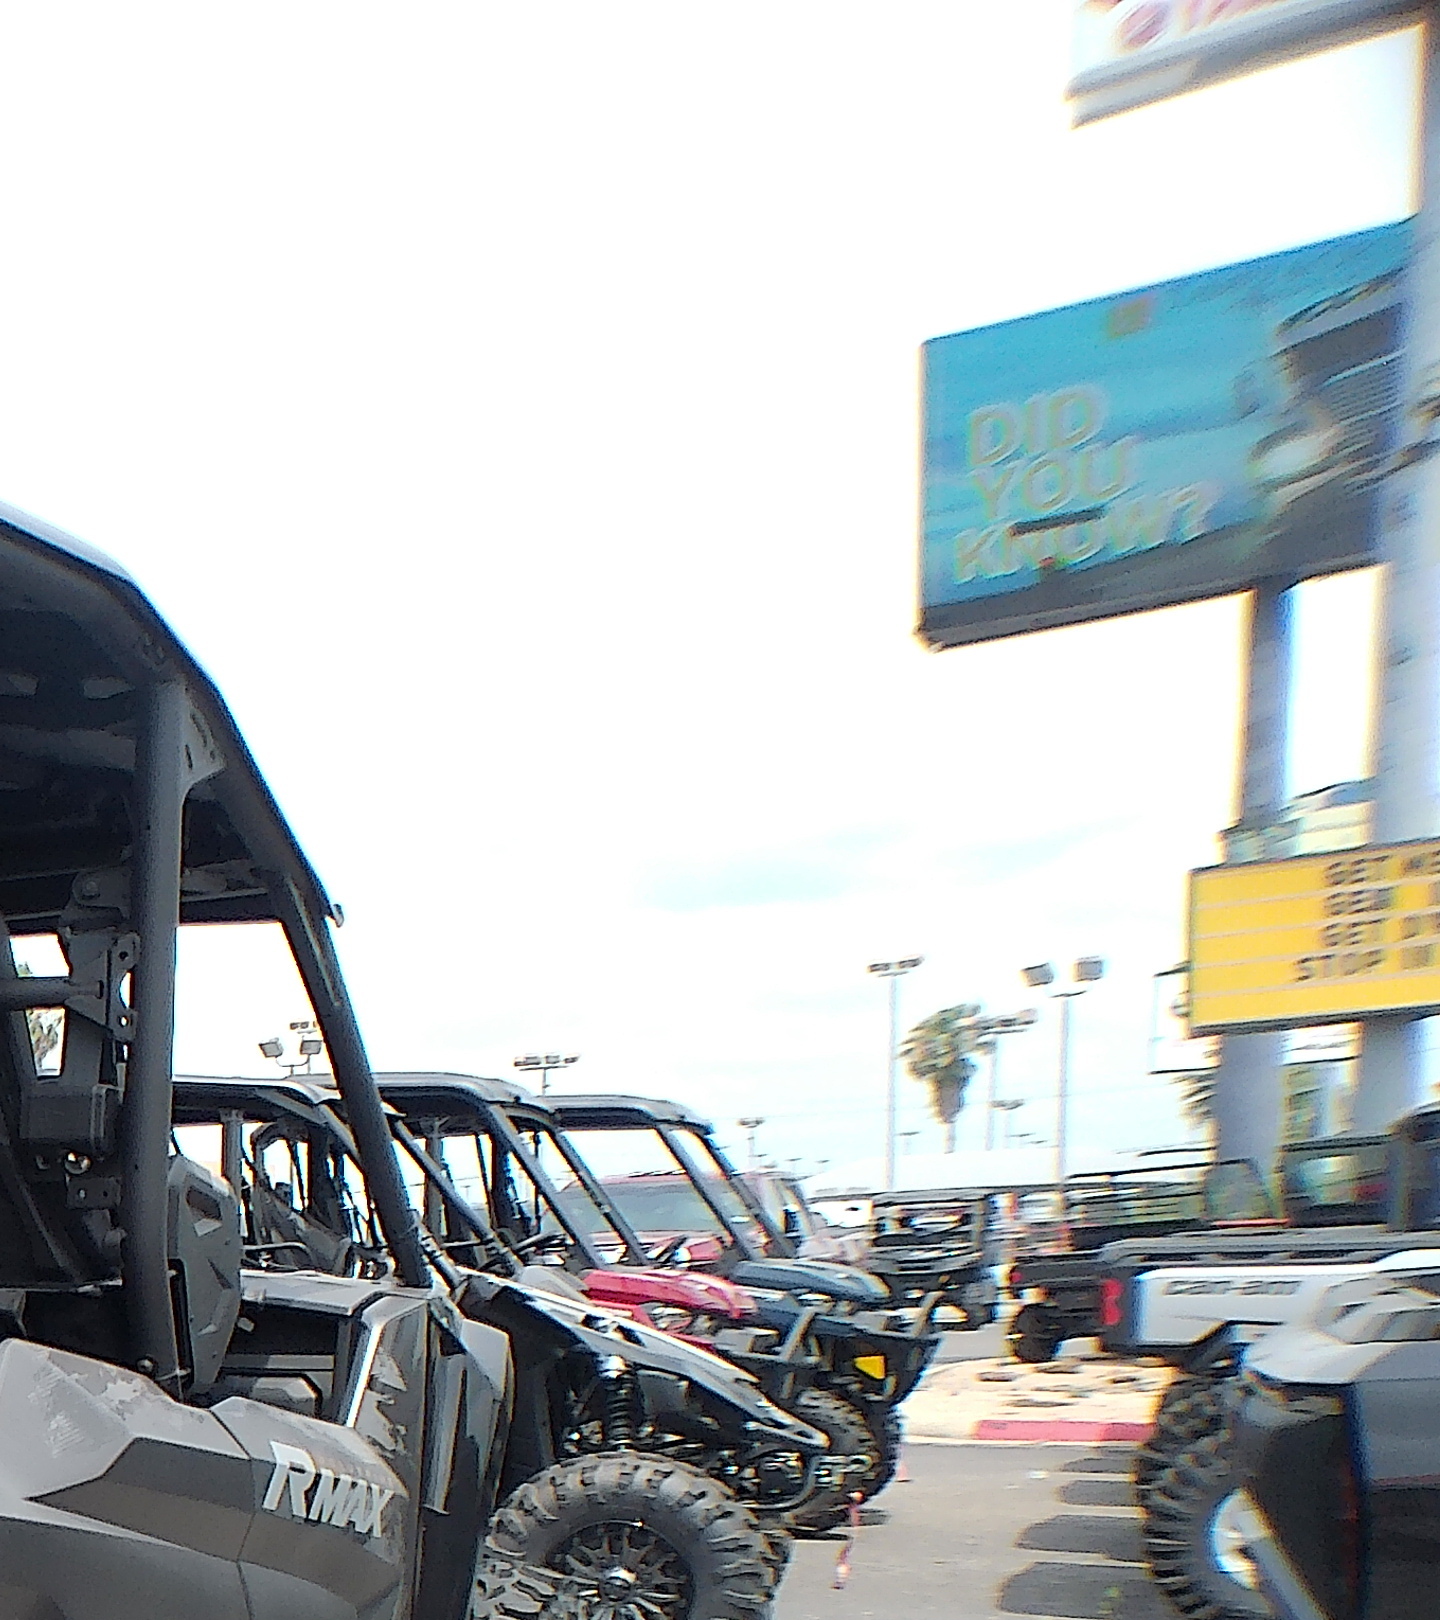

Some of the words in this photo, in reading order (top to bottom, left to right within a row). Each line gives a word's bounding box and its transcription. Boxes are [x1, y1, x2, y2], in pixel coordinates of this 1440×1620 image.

[968, 384, 1110, 467] DID
[968, 433, 1142, 522] YOU
[953, 483, 1220, 585] KNOW?
[262, 1440, 396, 1538] RMAX
